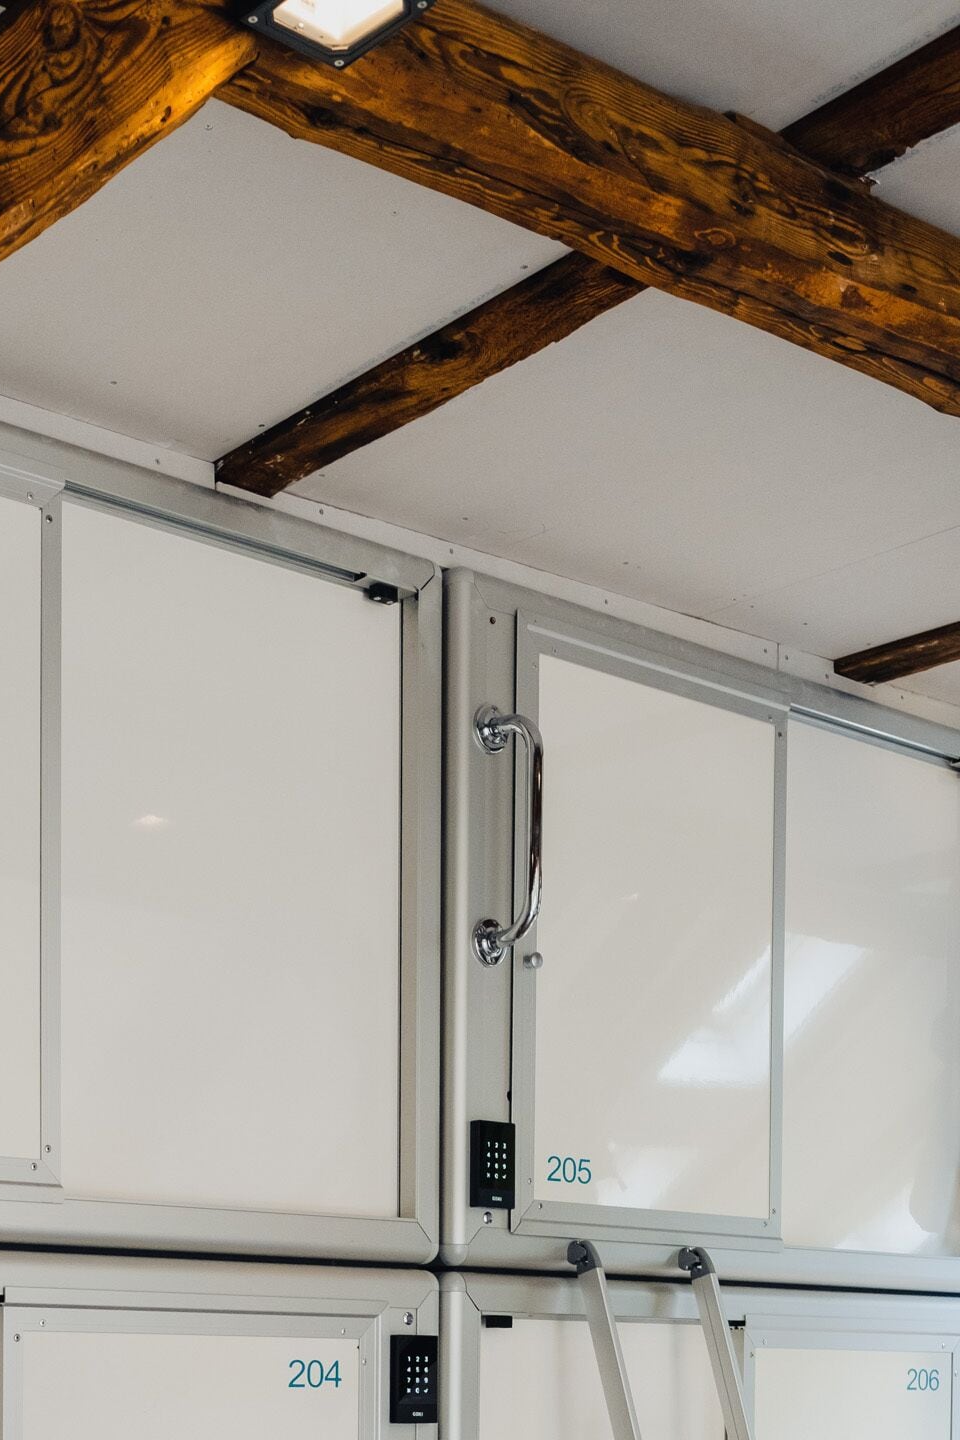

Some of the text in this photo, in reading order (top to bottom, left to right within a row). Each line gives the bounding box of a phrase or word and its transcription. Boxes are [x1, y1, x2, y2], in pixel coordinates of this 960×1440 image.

[547, 1156, 591, 1184] 205
[288, 1360, 341, 1388] 204
[907, 1368, 939, 1391] 206
